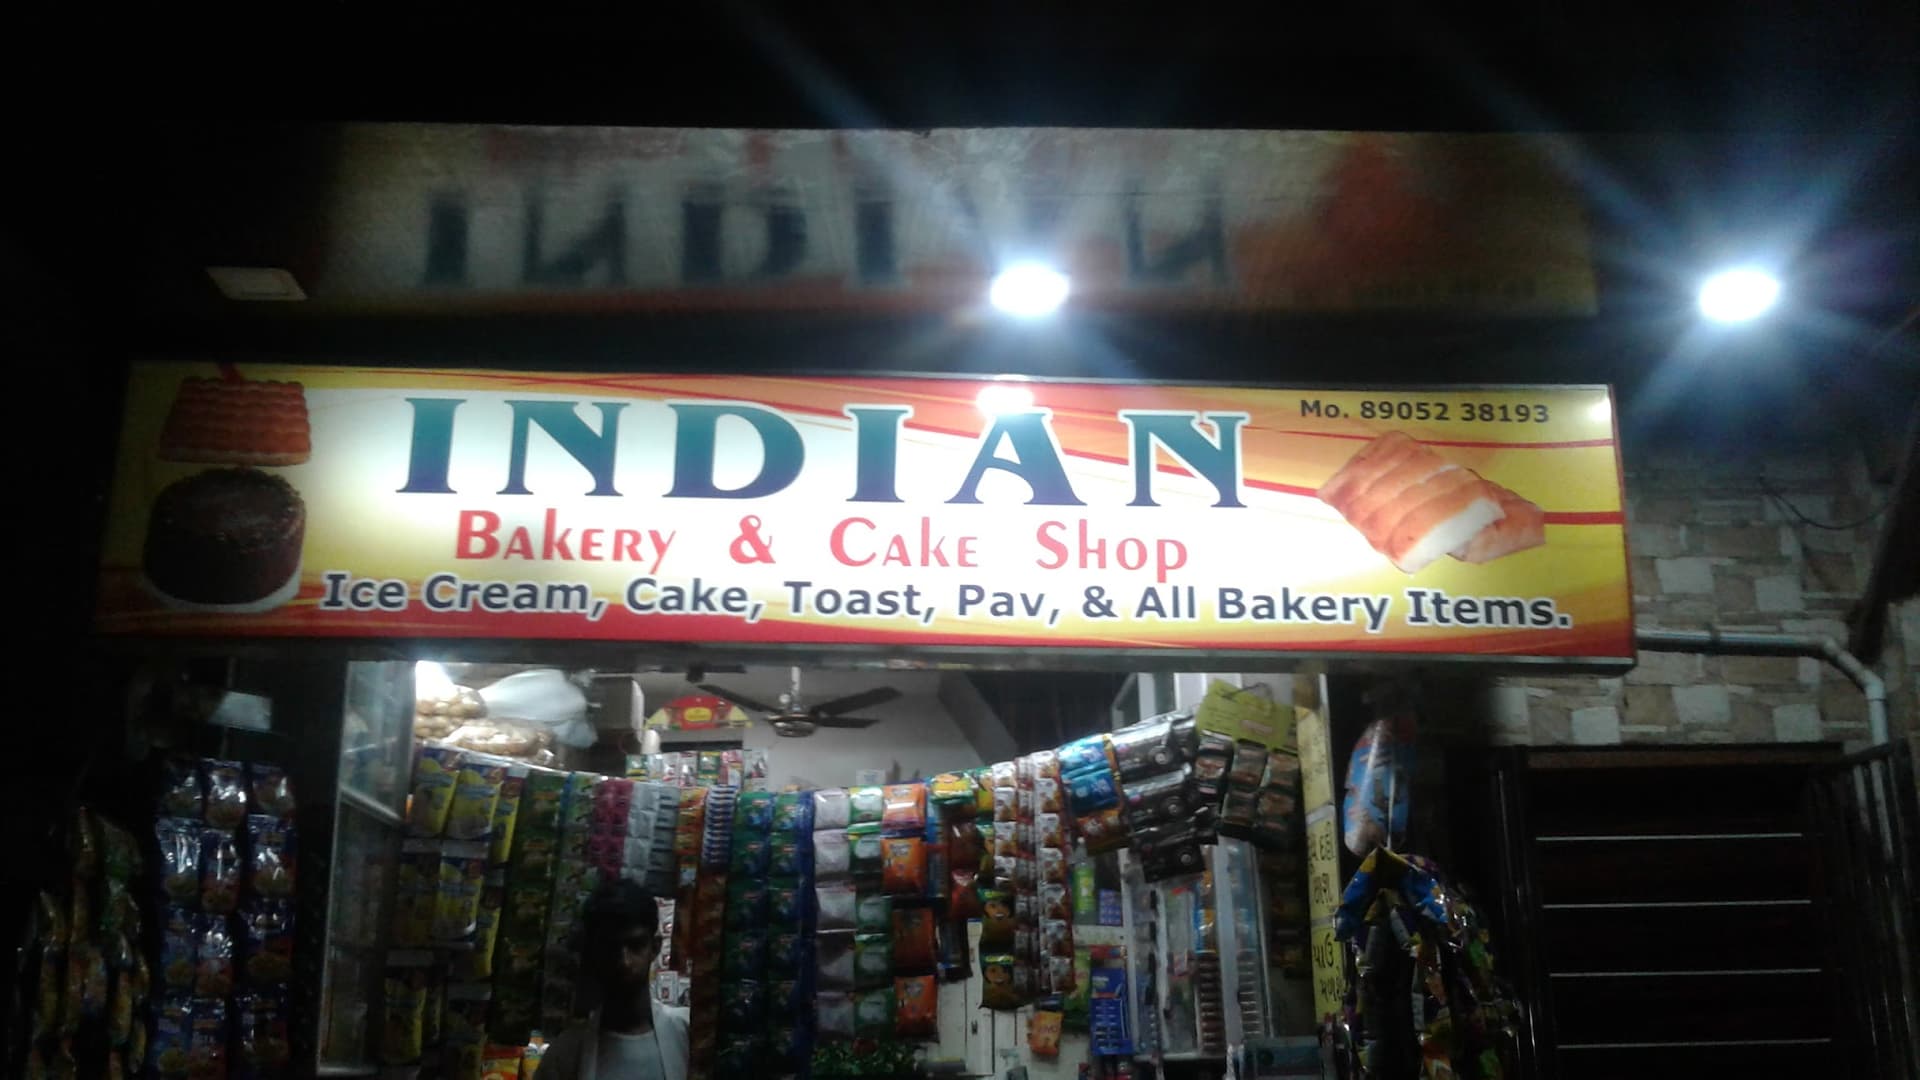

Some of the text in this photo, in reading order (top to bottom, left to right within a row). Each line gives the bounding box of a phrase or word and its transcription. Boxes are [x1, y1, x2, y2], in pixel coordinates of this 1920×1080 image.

[1300, 399, 1550, 423] Mo. 89052 38193
[396, 398, 1251, 508] INDIAN
[729, 514, 776, 564] &
[1036, 518, 1188, 584] Shop
[323, 573, 1570, 631] Ice Cream, Cake, Toast, Pav, & All Bakery Items.
